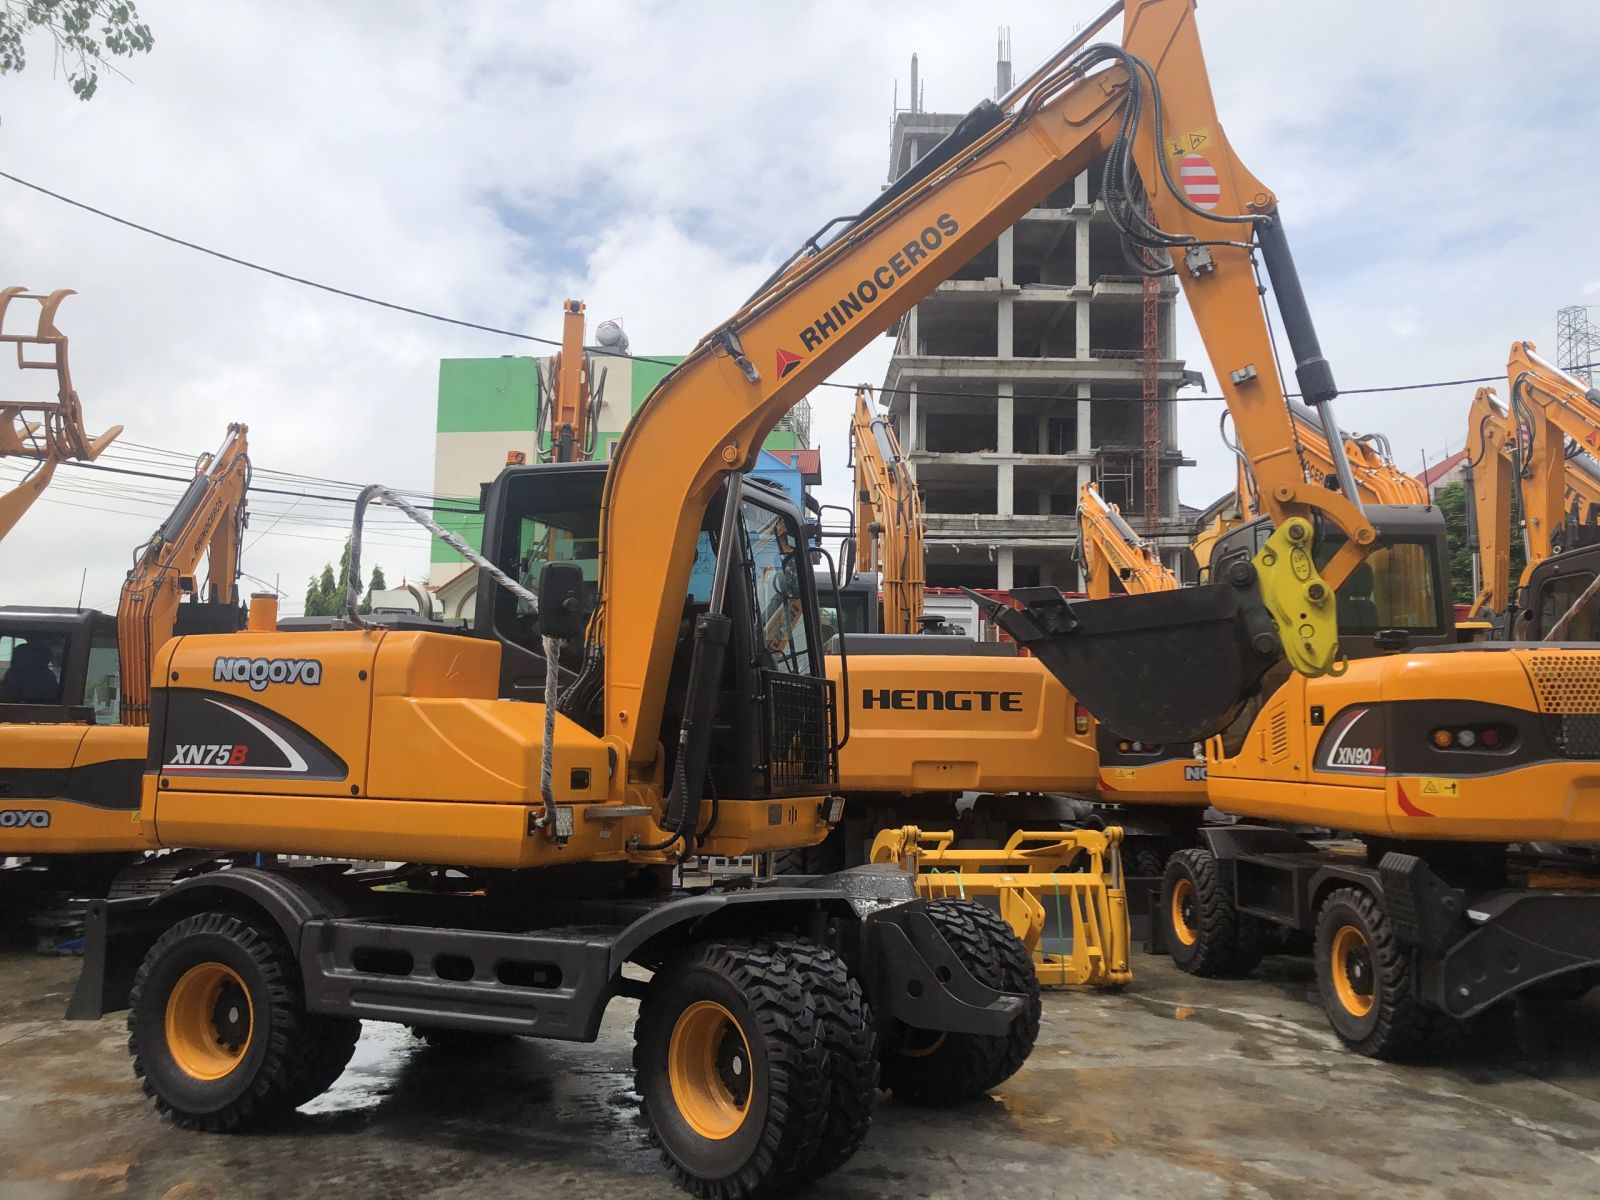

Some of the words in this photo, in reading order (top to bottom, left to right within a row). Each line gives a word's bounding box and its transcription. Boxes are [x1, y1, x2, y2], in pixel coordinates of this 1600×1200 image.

[799, 213, 958, 352] RHINOCEROS
[194, 497, 222, 552] RHINOCEROS
[213, 657, 322, 692] Nagoya
[862, 689, 1023, 712] HENGTE
[169, 744, 249, 765] XN75B
[0, 809, 51, 828] oya
